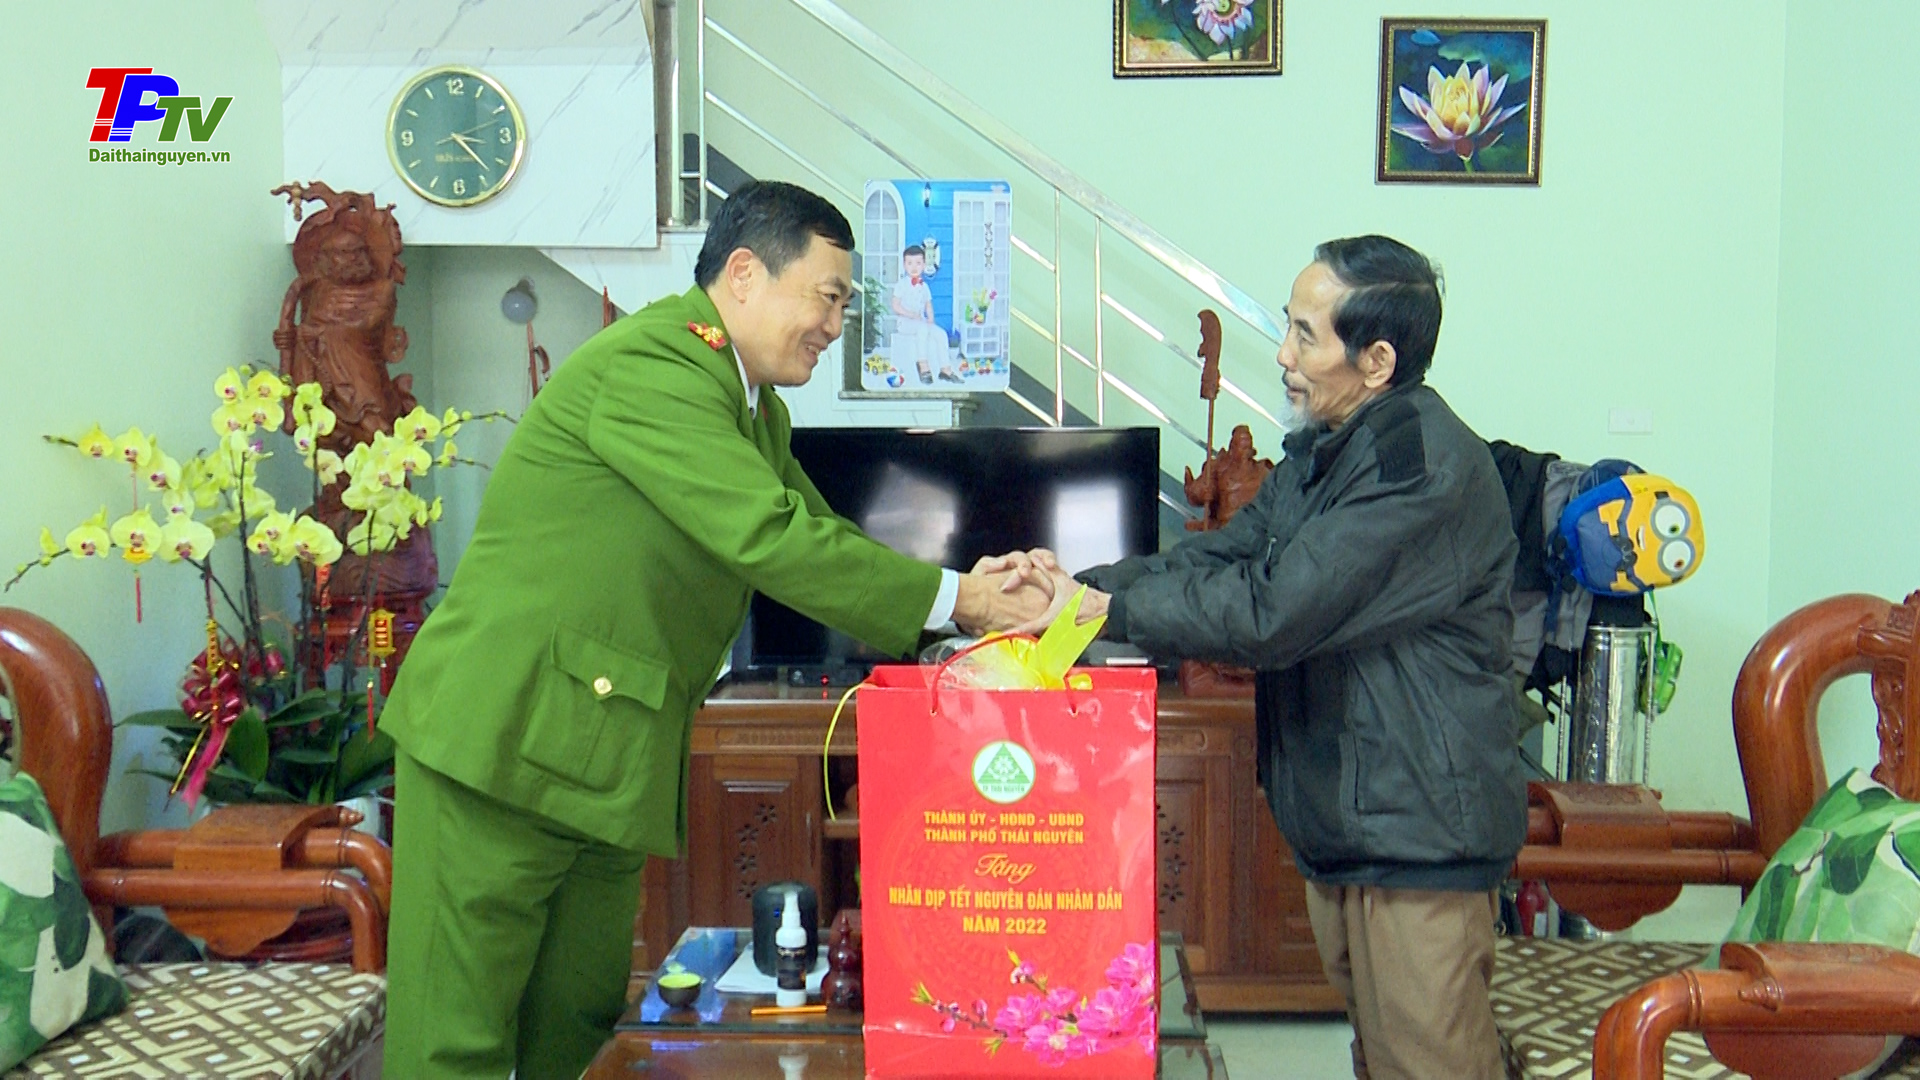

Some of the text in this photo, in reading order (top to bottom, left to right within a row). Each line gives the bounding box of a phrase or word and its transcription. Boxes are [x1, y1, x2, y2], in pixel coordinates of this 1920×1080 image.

[445, 77, 465, 96] 12
[401, 129, 414, 147] 9
[499, 127, 512, 144] 3
[453, 179, 466, 196] 6
[924, 809, 966, 824] THÀNH
[1048, 812, 1085, 827] UBND
[924, 826, 1084, 844] THÀNH PHỐ THÁI NGUYÊN
[974, 852, 1037, 884] Tặng
[888, 884, 922, 906] NHÂN
[924, 888, 946, 911] DỊP
[949, 884, 971, 908] TẾT
[974, 887, 1024, 910] NGUYÊN
[1027, 887, 1053, 910] ĐÁN
[1056, 887, 1094, 910] NHÂM
[962, 913, 1047, 934] NĂM 2022
